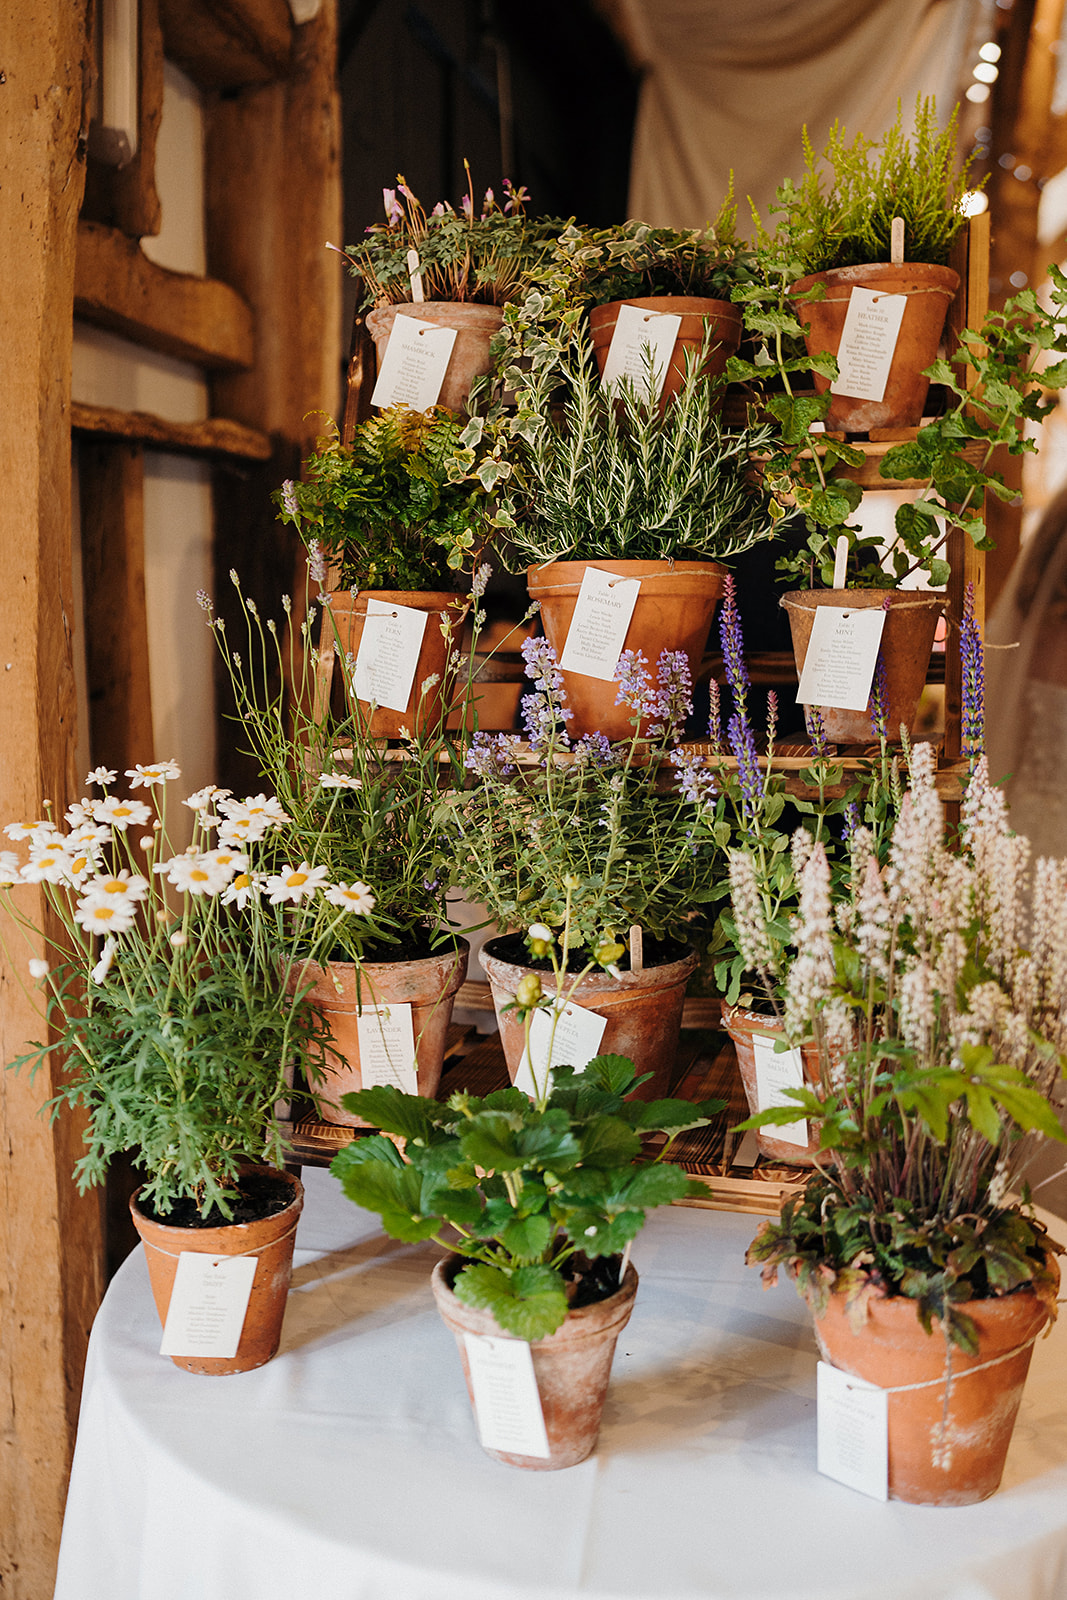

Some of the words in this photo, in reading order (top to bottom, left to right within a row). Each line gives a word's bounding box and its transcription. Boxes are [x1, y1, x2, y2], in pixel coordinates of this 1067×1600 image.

[858, 312, 889, 324] HEATHER
[401, 344, 436, 357] SHAMROCK
[587, 595, 622, 609] ROSEMARY
[385, 627, 401, 636] FERN
